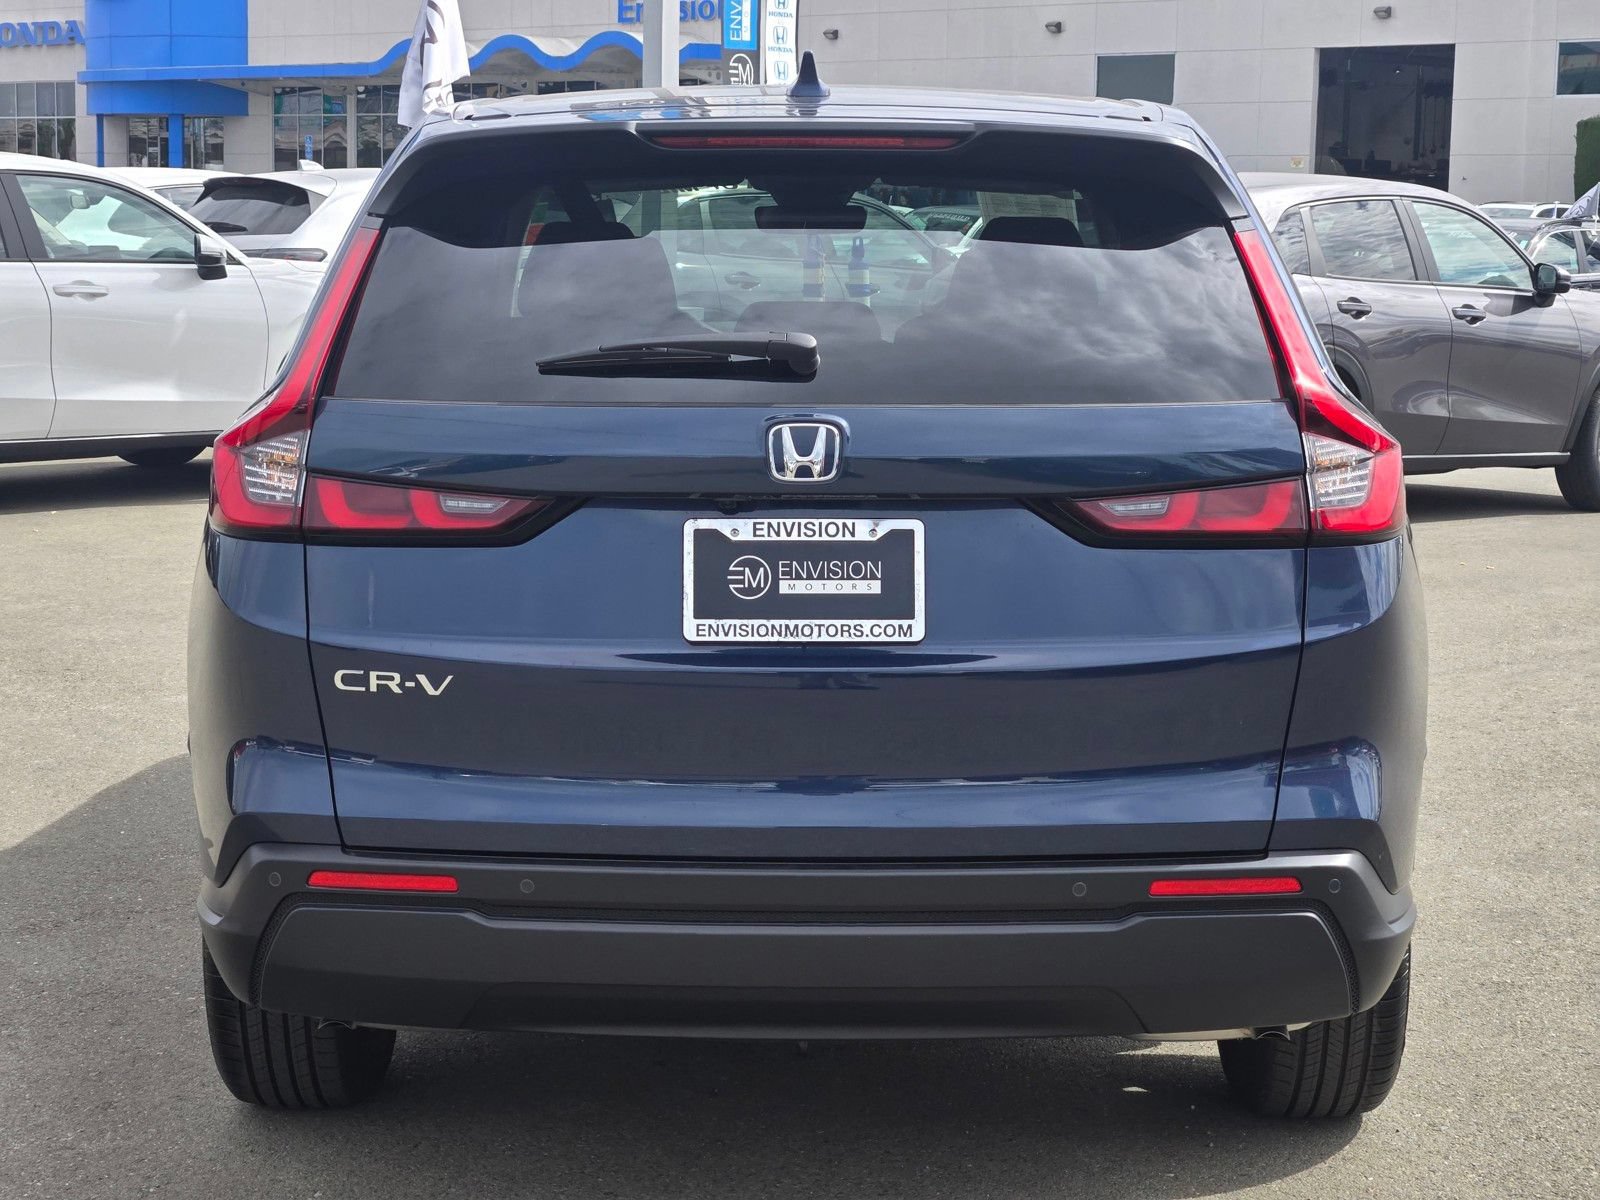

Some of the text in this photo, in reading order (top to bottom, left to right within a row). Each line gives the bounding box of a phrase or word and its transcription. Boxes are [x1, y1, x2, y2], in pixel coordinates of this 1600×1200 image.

[752, 521, 856, 538] ENVISION
[778, 560, 882, 579] ENVISION
[787, 583, 873, 591] MOTORS
[695, 623, 913, 638] ENVISIONMOTORS.COM
[333, 669, 454, 696] CR-V
